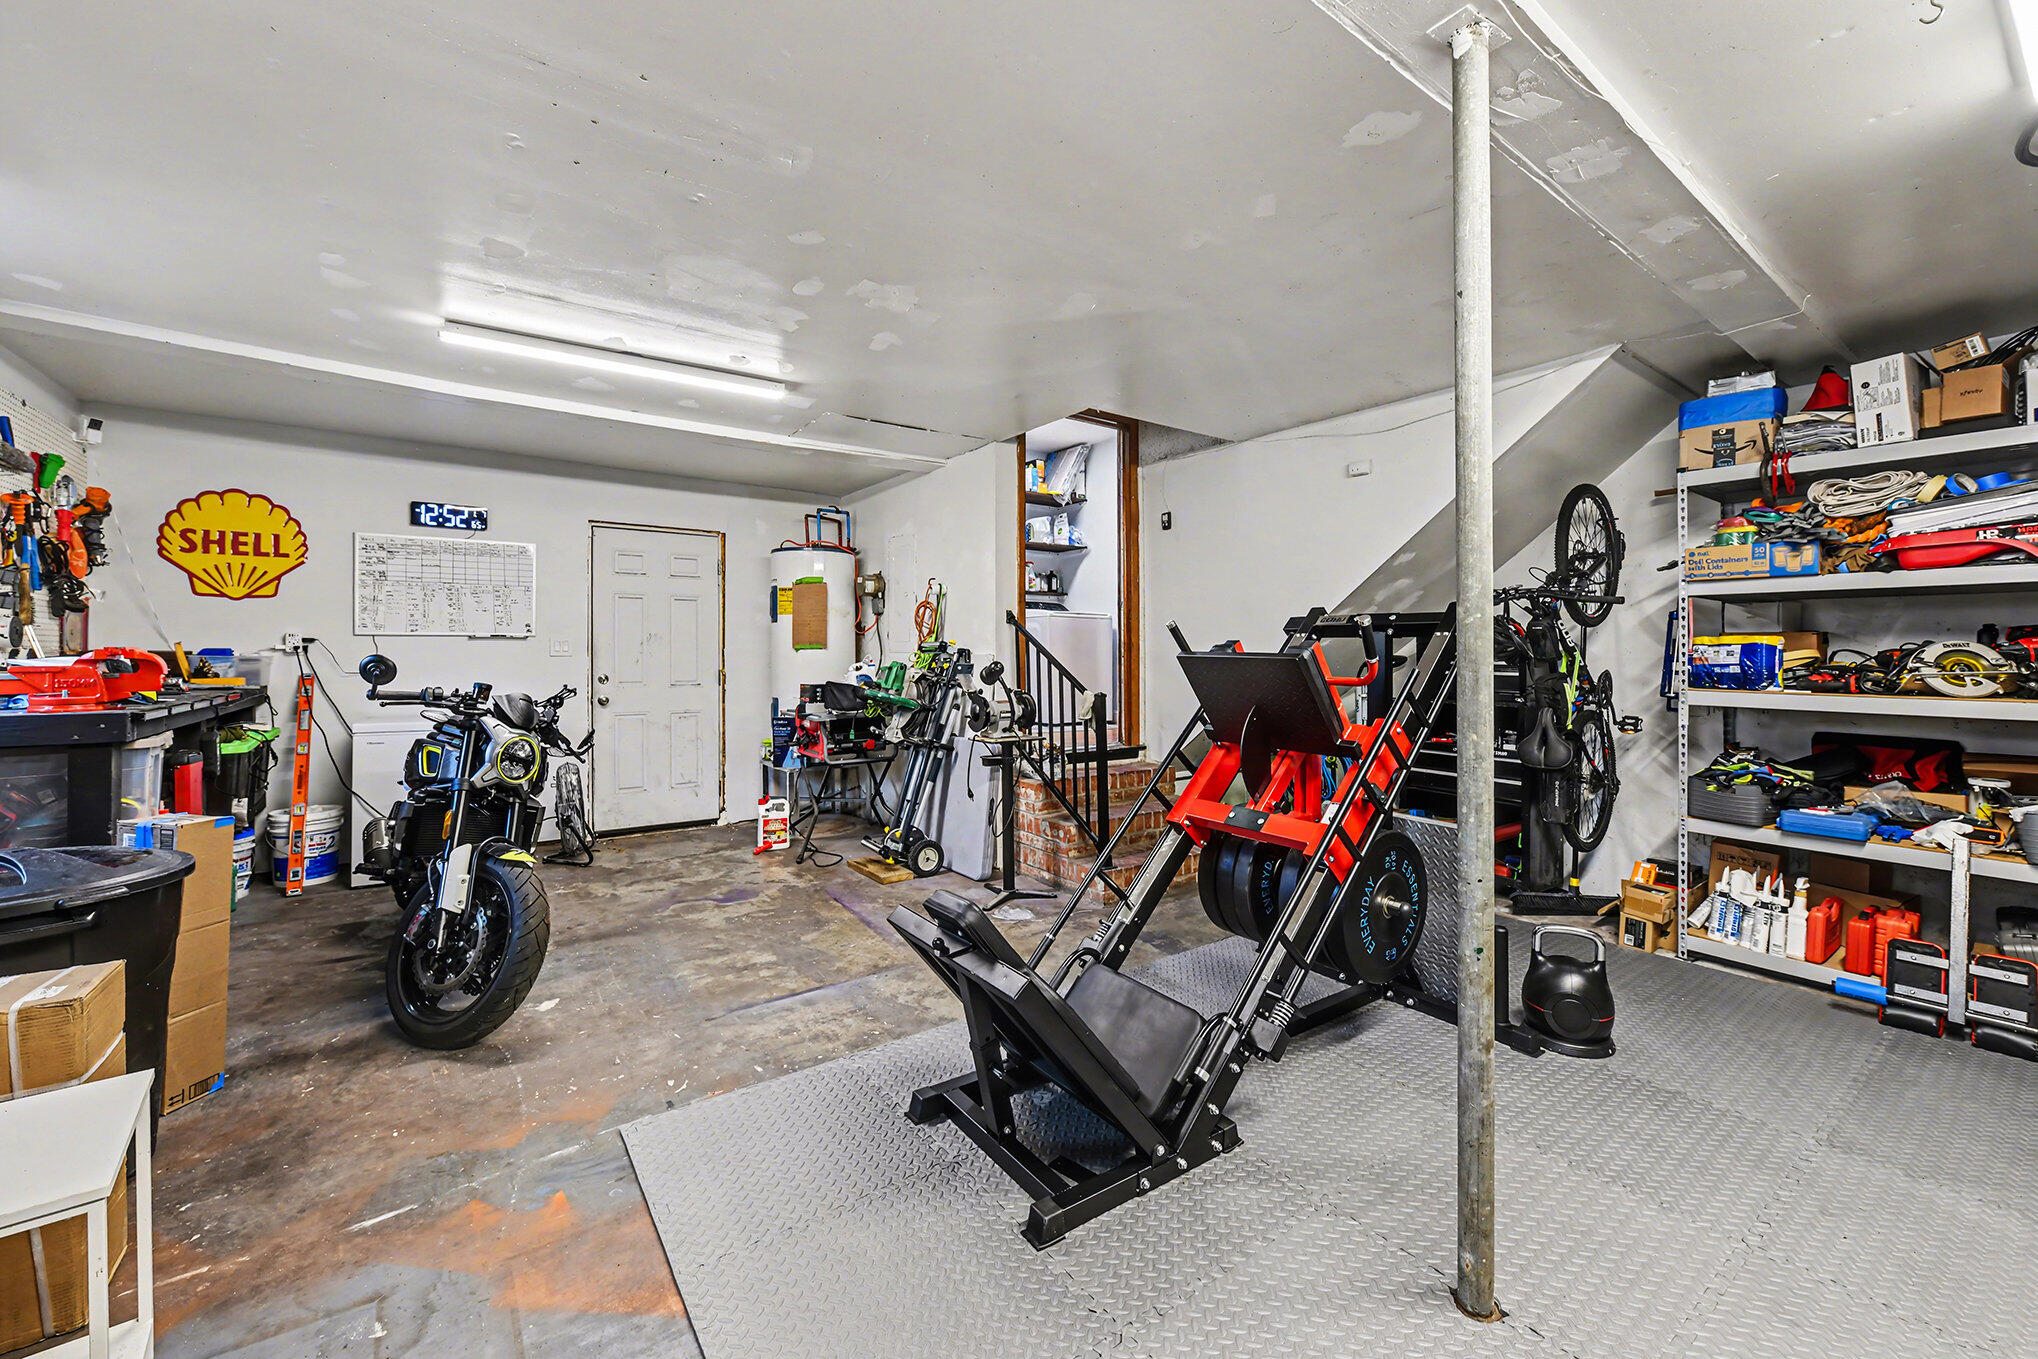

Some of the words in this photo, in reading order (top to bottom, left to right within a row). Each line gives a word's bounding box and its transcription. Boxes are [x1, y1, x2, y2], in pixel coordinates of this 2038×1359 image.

[178, 527, 290, 558] SHELL
[1705, 557, 1748, 565] Containers
[1360, 875, 1376, 954] EVERYDAY
[1401, 859, 1419, 947] ESSENTIALS
